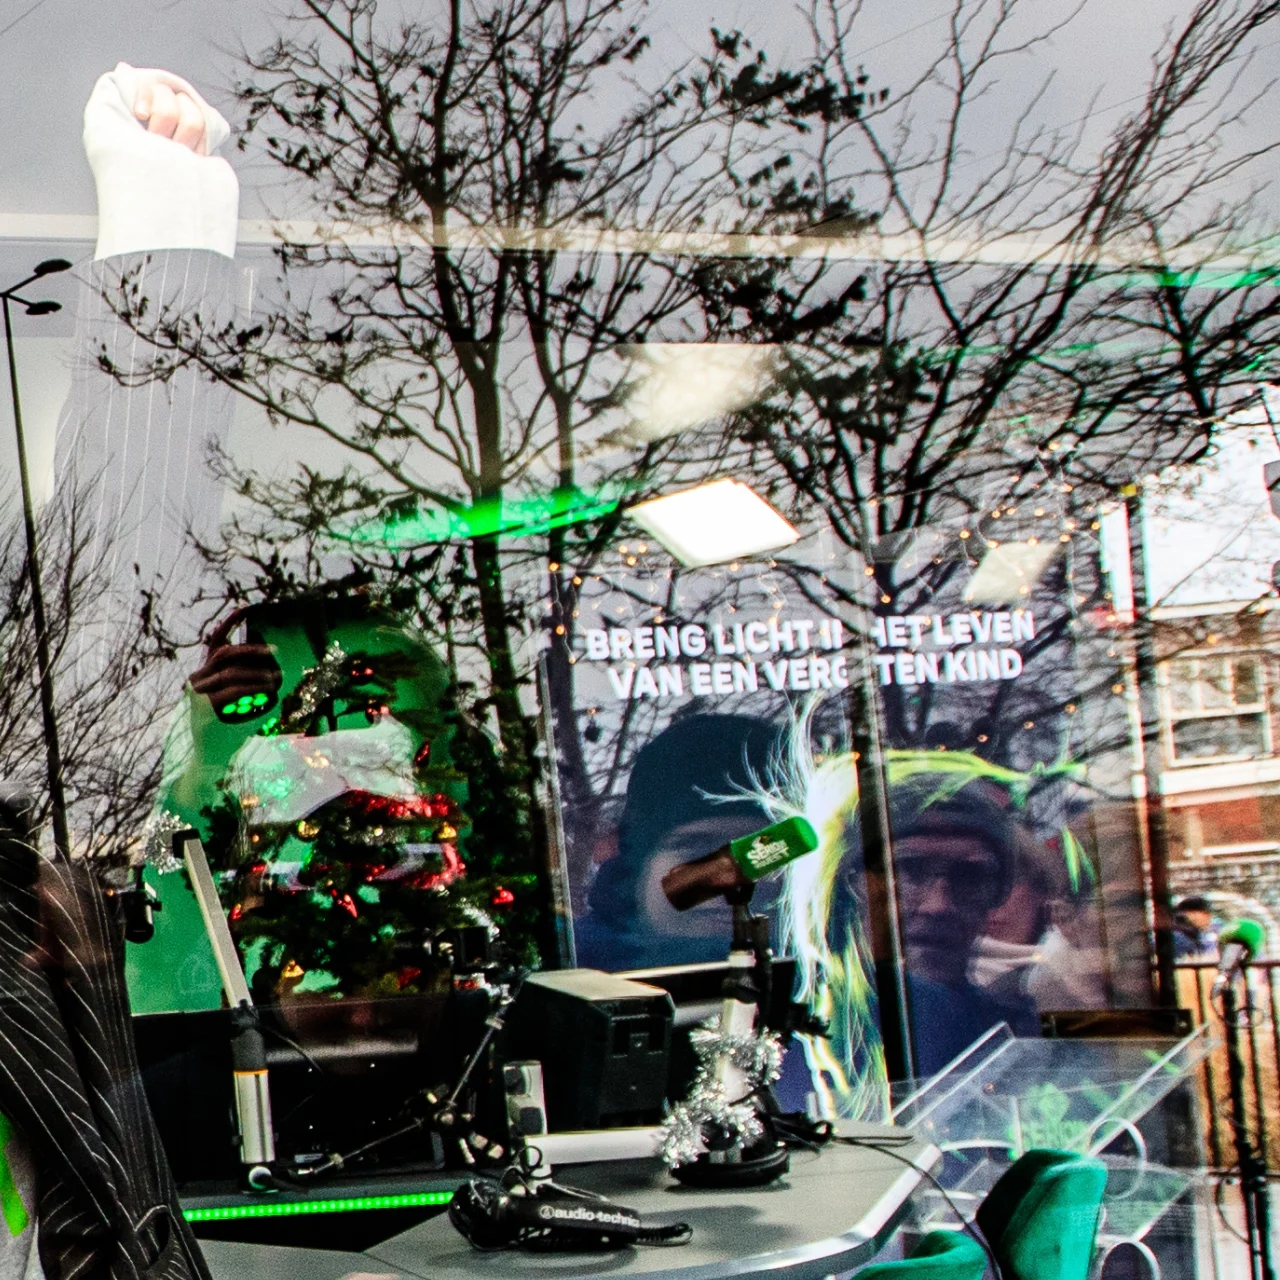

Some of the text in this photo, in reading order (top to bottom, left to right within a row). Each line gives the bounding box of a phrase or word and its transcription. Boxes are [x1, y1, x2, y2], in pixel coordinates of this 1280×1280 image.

[585, 623, 706, 661] BRENG
[715, 619, 814, 655] LICHT
[933, 610, 1034, 645] LEVEN
[607, 663, 683, 699] VAN
[690, 659, 758, 695] EEN
[946, 648, 1023, 684] KIND
